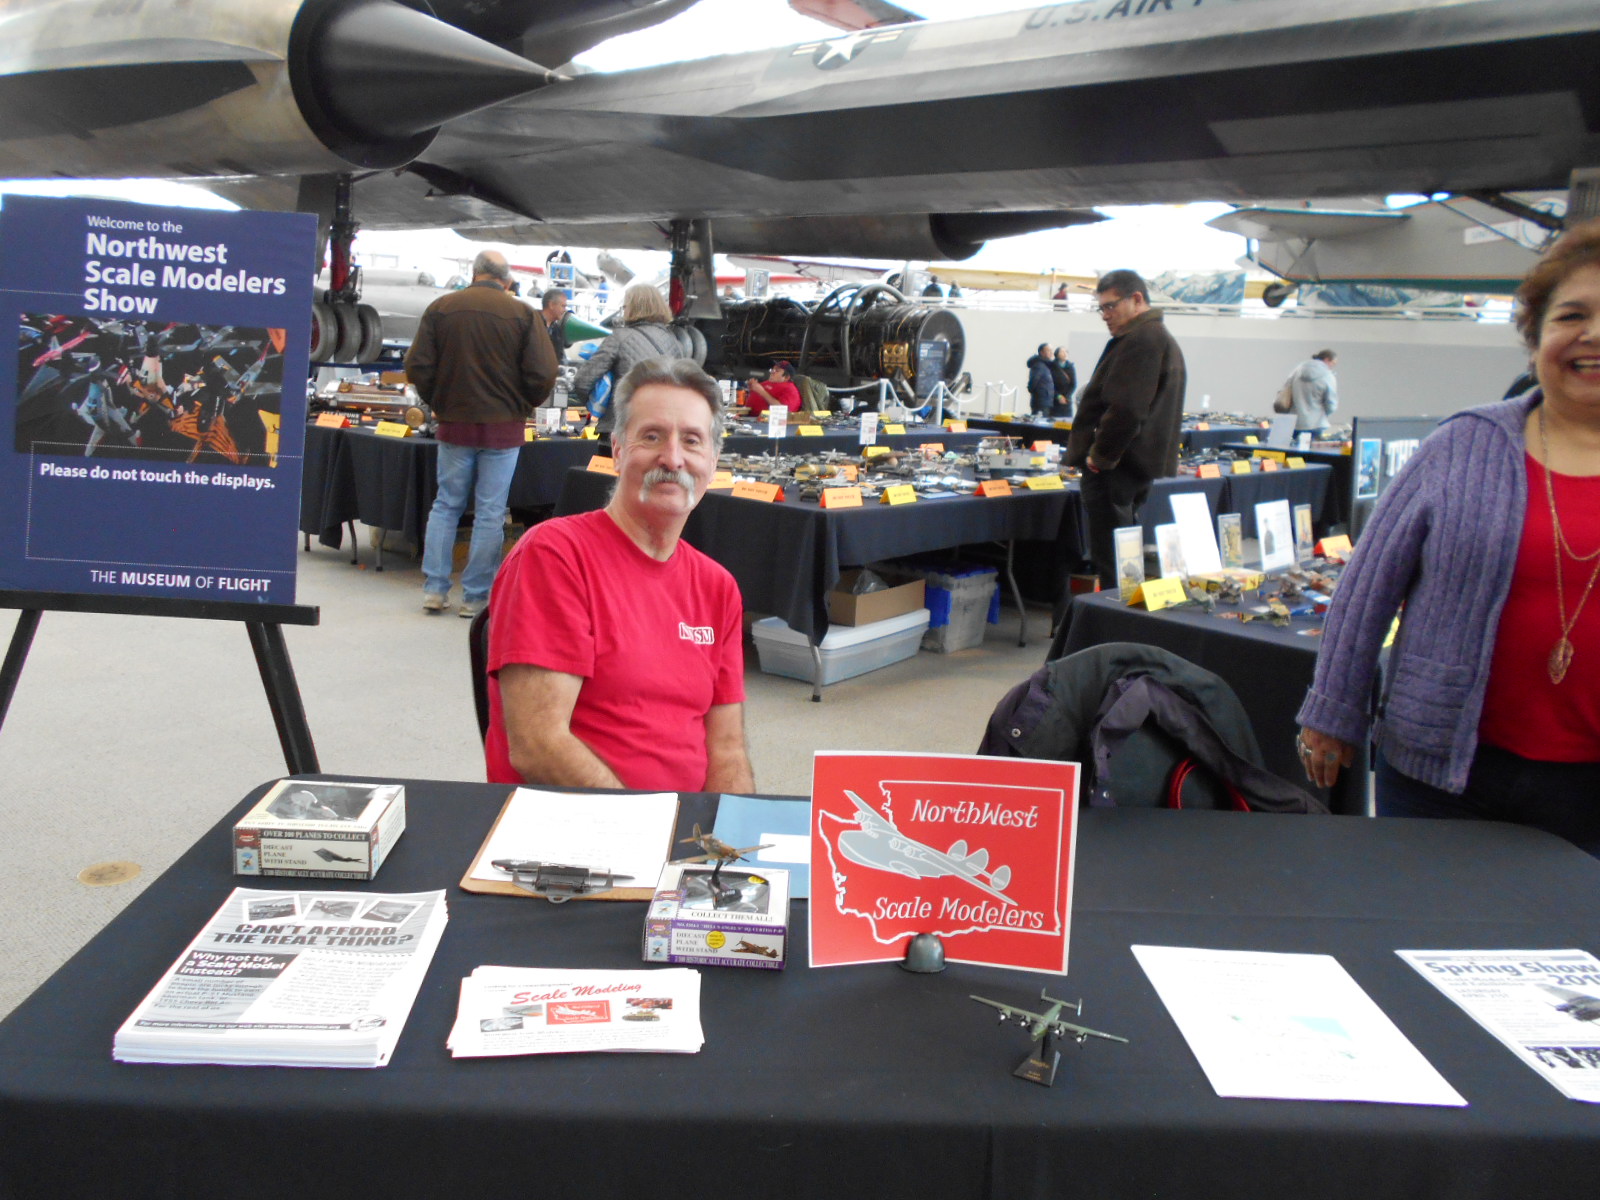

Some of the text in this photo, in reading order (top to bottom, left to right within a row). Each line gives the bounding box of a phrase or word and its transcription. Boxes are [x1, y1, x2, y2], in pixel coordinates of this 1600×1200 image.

[87, 215, 183, 234] Welcome to the
[86, 232, 228, 264] Northwest
[85, 260, 286, 295] Scale Modelers
[84, 288, 158, 314] Show
[40, 463, 276, 491] Please do not touch the displays.
[91, 570, 271, 592] THE MUSEUM OF FLIGHT
[295, 831, 322, 839] PLANES
[333, 832, 366, 840] COLLECT
[872, 896, 1044, 928] Scale Modelers
[213, 932, 415, 946] THE REAL THING?
[235, 924, 397, 937] CAN'T AFFORD
[192, 952, 224, 962] Why
[253, 955, 274, 963] try
[197, 960, 237, 968] Scale
[238, 962, 286, 970] Model
[1424, 961, 1600, 977] Spring Show
[510, 982, 642, 1005] Scale Modeling
